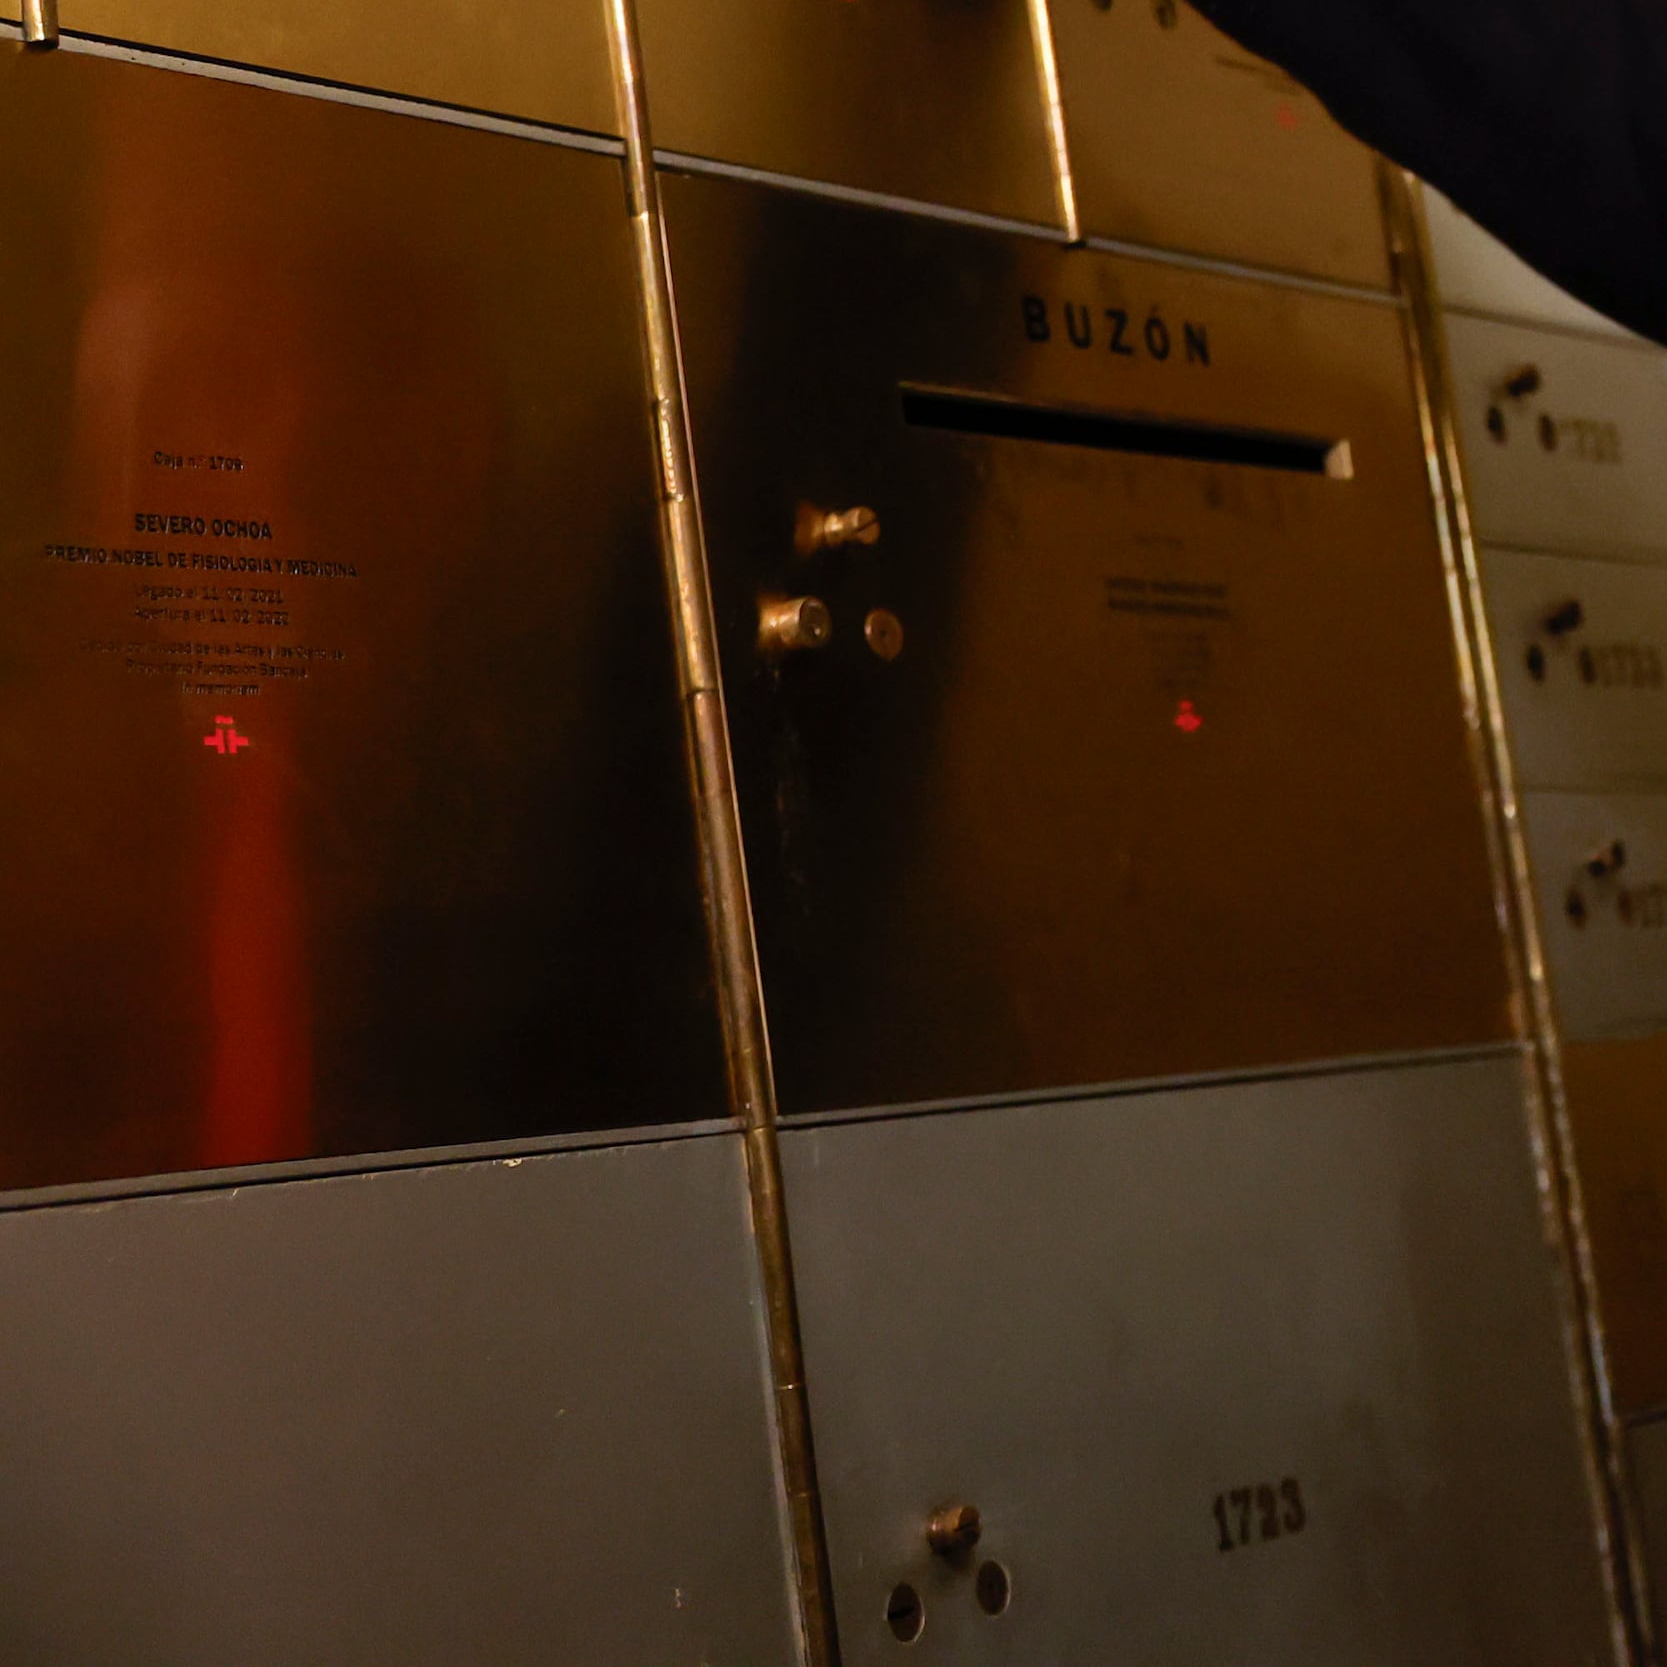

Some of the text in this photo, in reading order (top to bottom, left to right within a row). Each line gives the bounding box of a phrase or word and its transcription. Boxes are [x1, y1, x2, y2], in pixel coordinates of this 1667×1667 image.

[1020, 293, 1212, 368] BUZÓN
[153, 451, 183, 470] Caja
[135, 513, 272, 540] SEVERO OCHOA
[45, 544, 108, 564] PREMIO
[113, 549, 163, 568] NOBEL
[168, 552, 186, 569] DE
[273, 558, 284, 575] Y
[287, 559, 358, 578] MEDICINA
[1213, 1477, 1306, 1552] 1723
